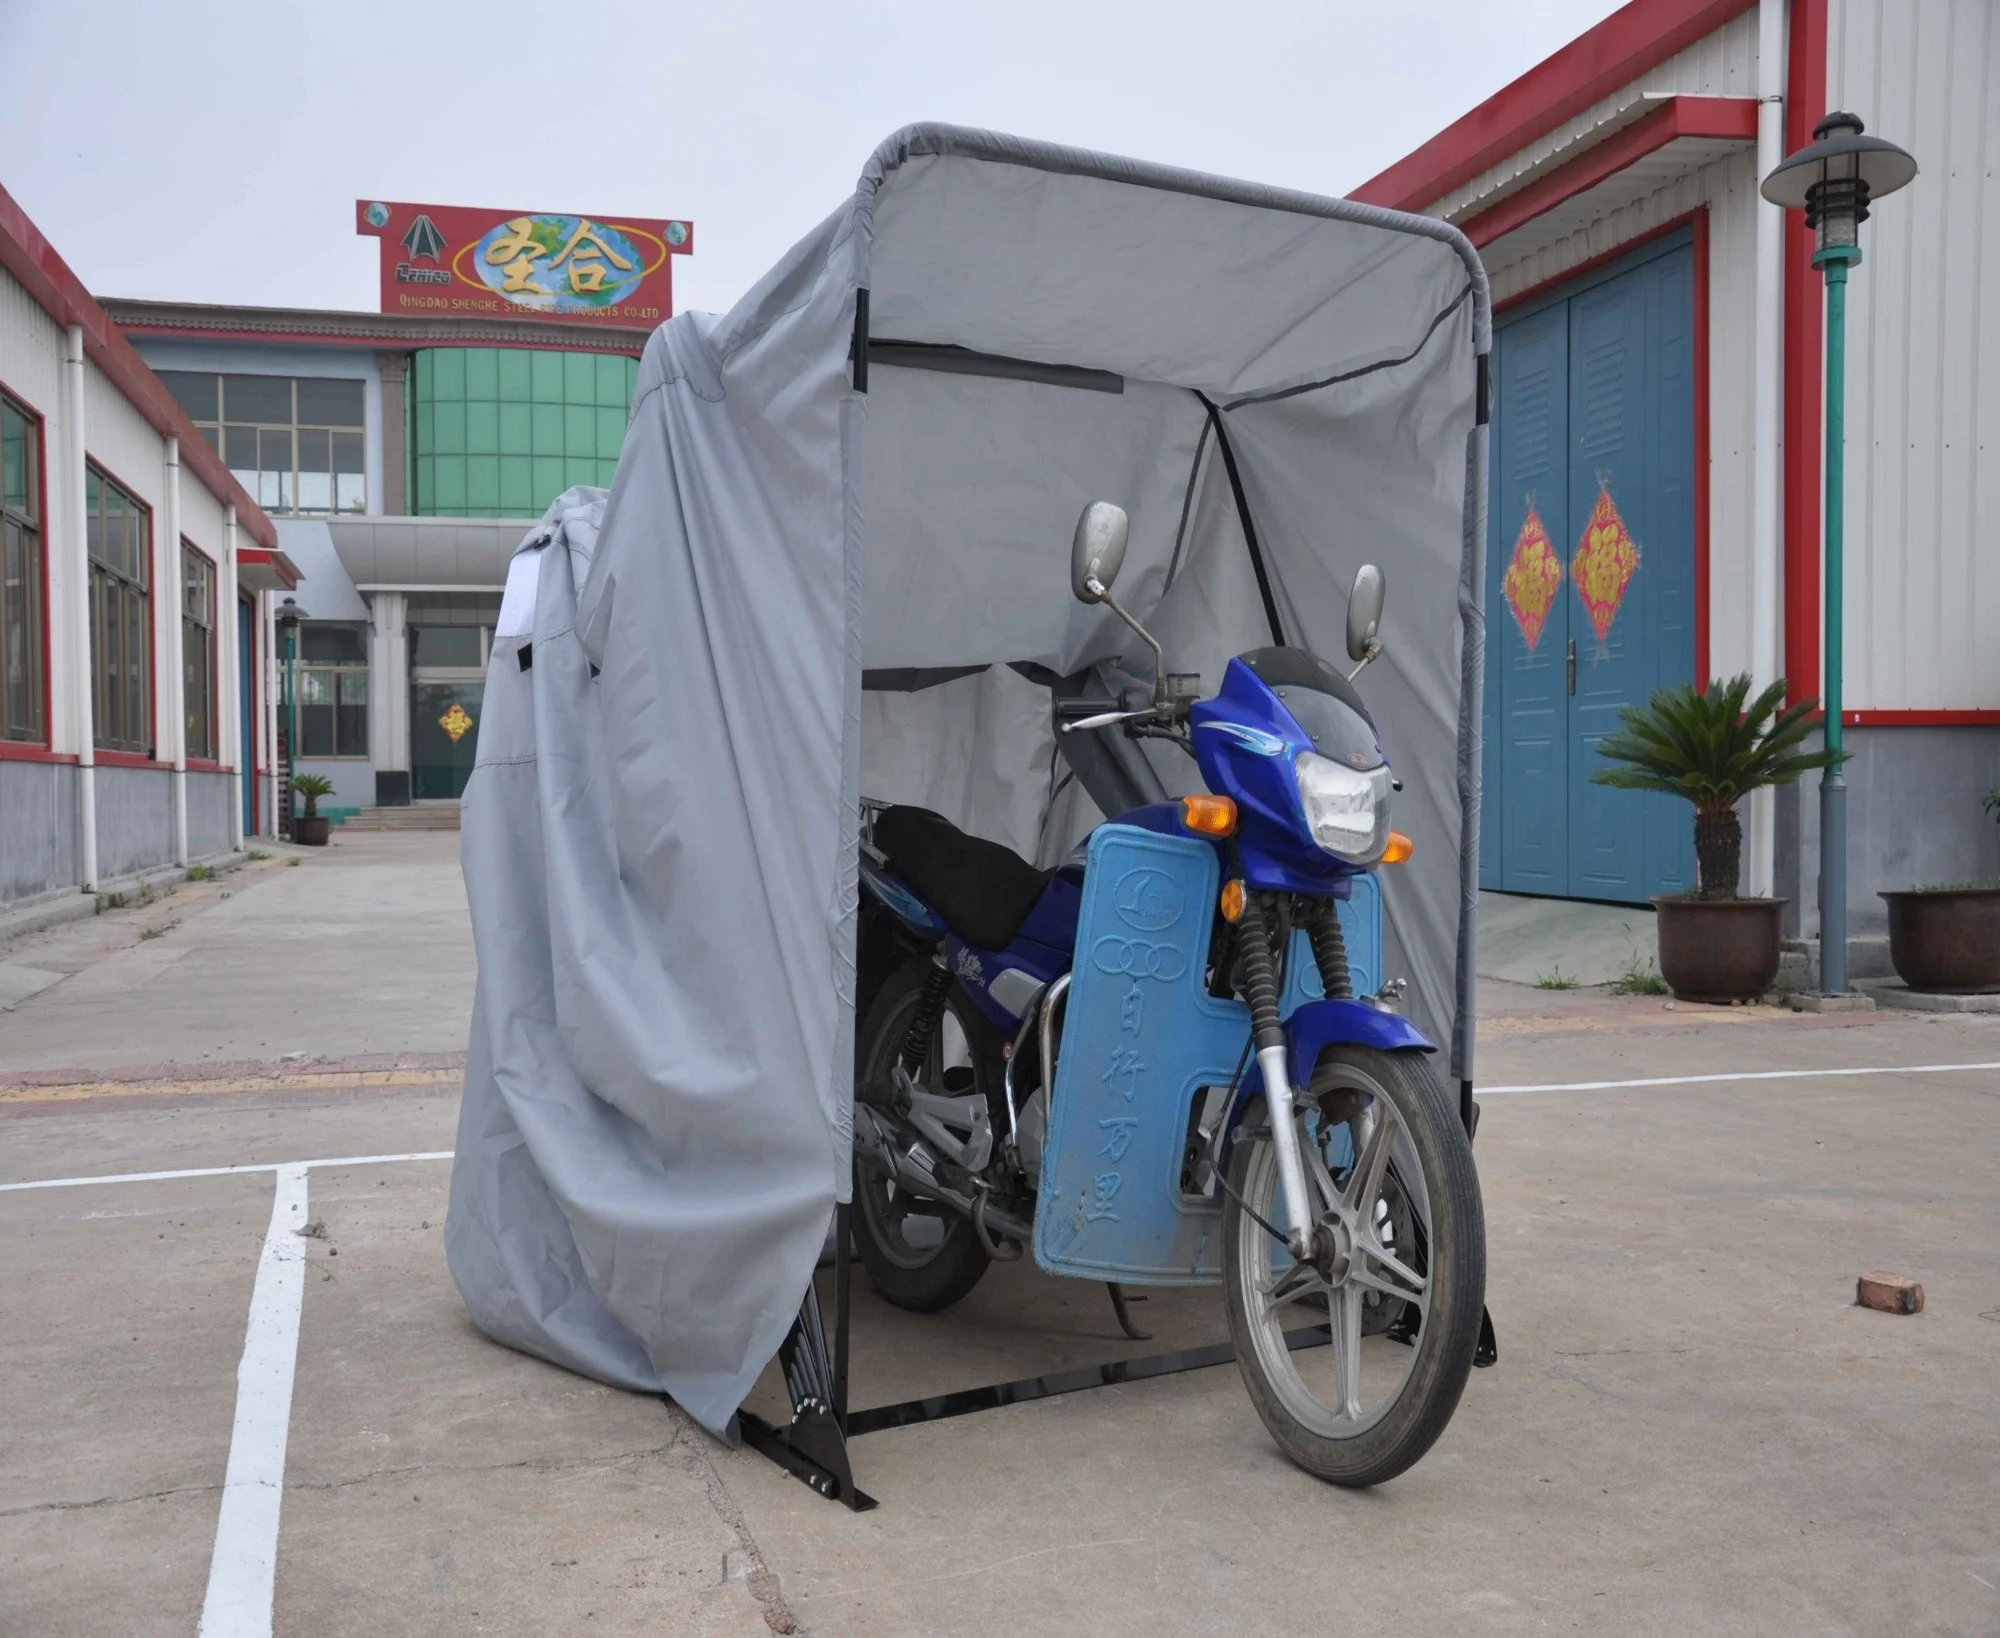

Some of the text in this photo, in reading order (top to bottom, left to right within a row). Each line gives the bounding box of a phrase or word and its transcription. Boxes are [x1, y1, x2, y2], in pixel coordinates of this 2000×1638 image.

[399, 294, 448, 309] QINGDAO
[452, 298, 498, 312] SHENGHE
[504, 301, 536, 314] STEEL
[567, 304, 618, 317] PRODUCTS
